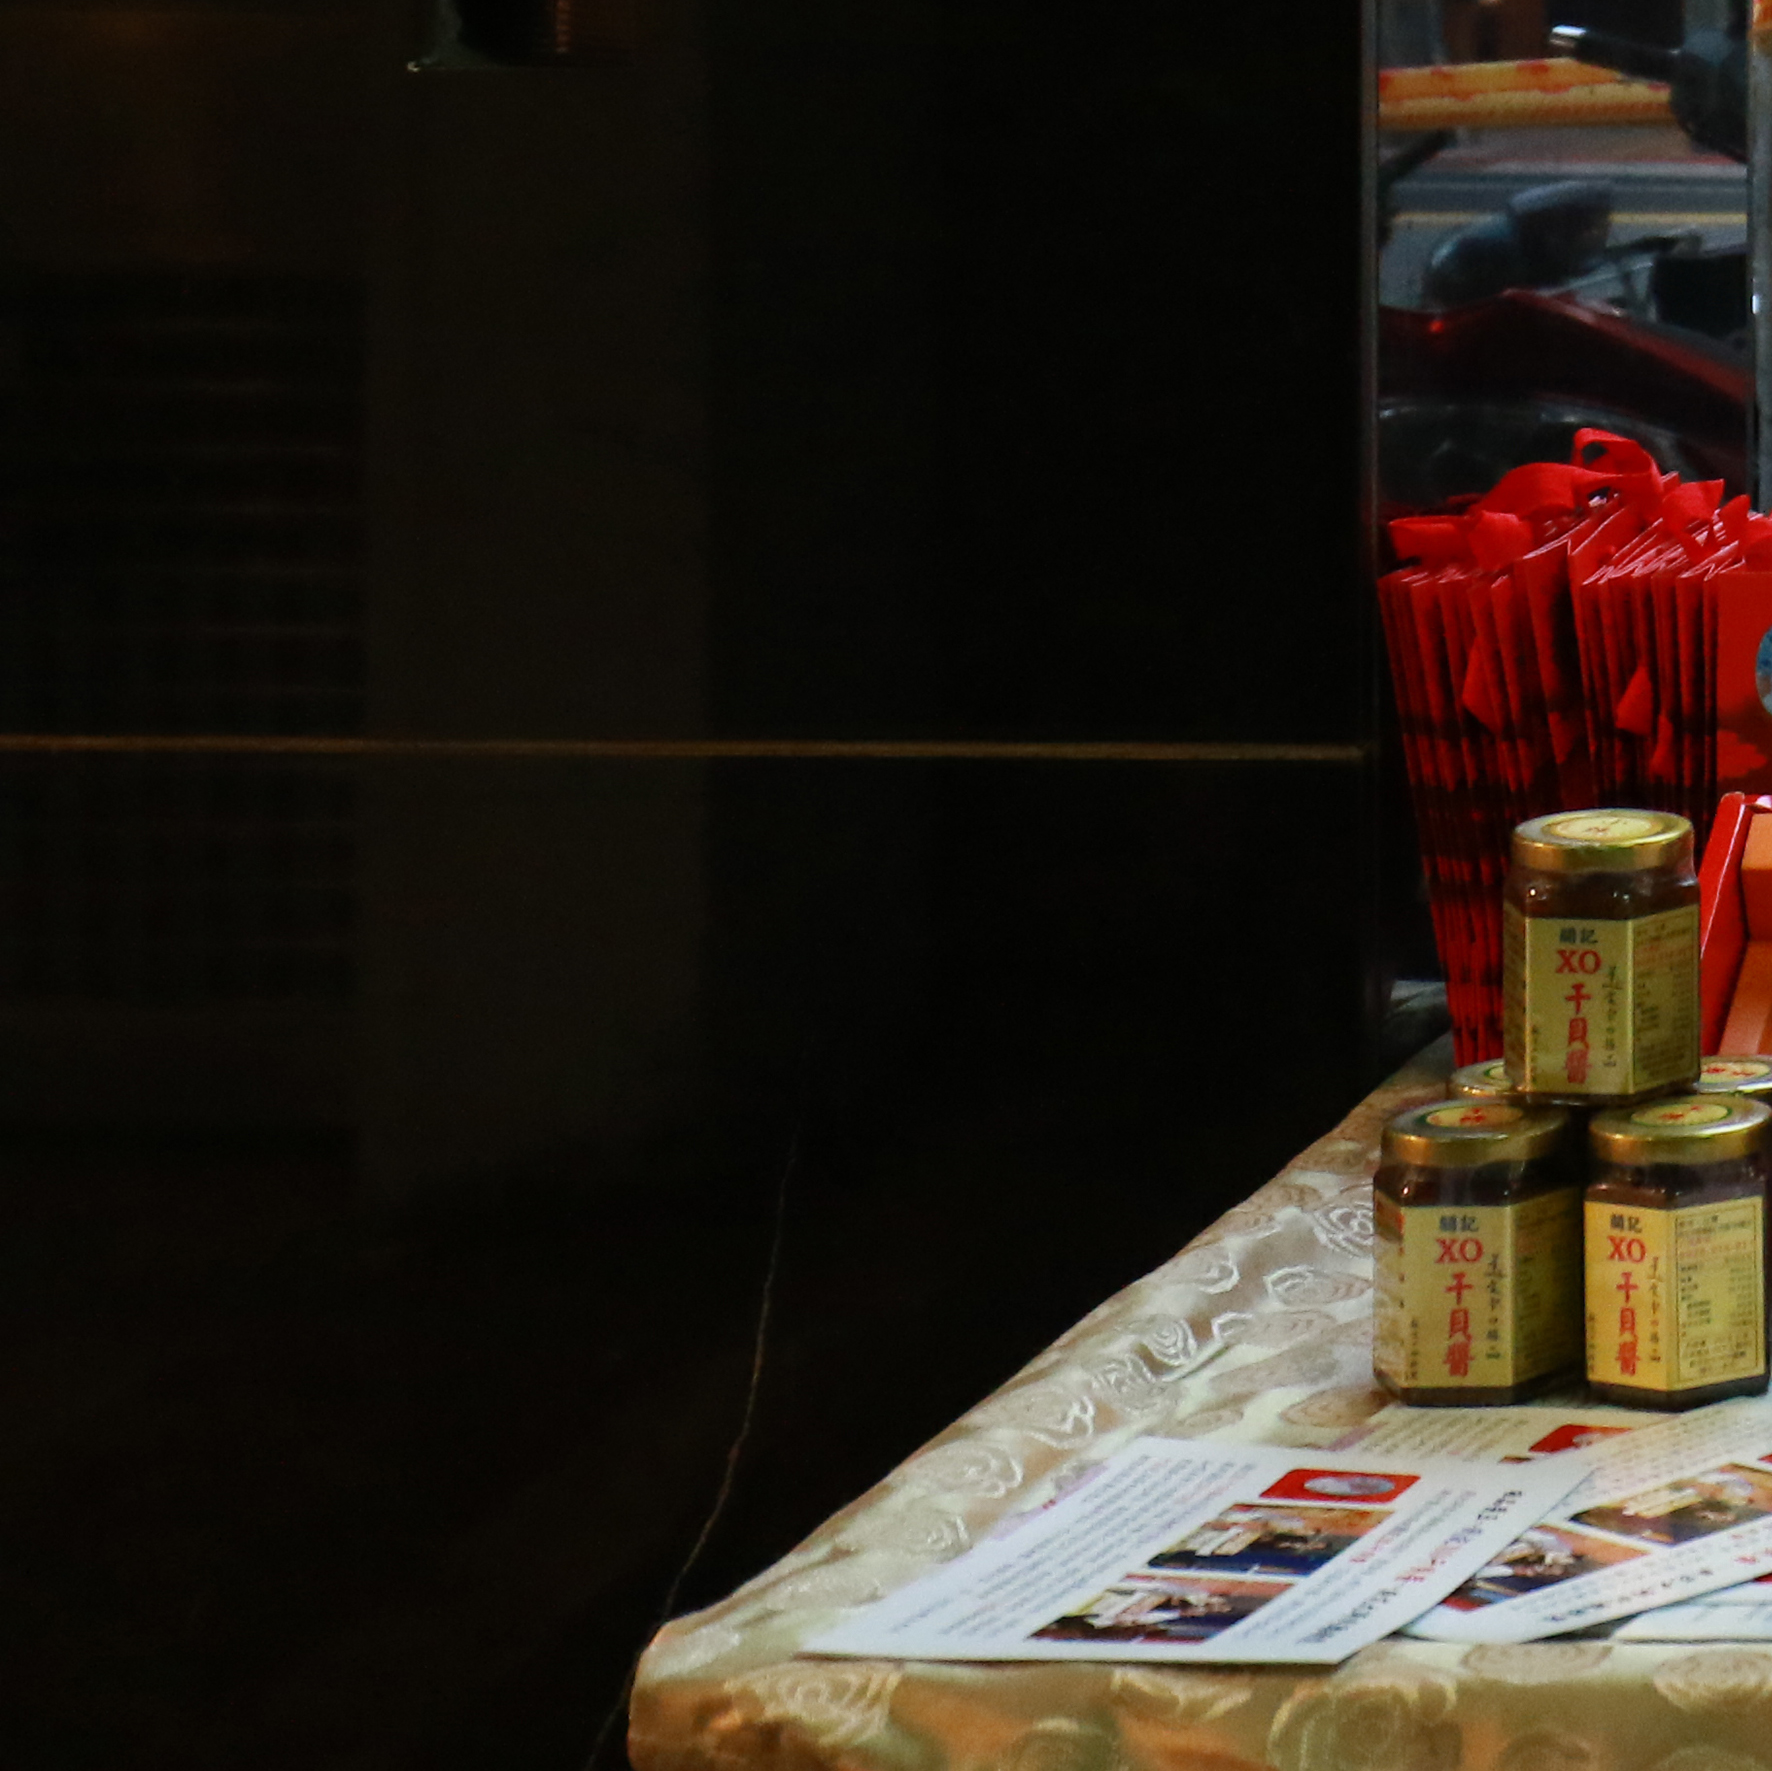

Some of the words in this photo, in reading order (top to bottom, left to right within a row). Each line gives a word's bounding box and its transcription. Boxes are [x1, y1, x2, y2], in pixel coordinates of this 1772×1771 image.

[1555, 949, 1601, 975] XO
[1435, 1238, 1484, 1264] XO
[1607, 1235, 1647, 1263] XO
